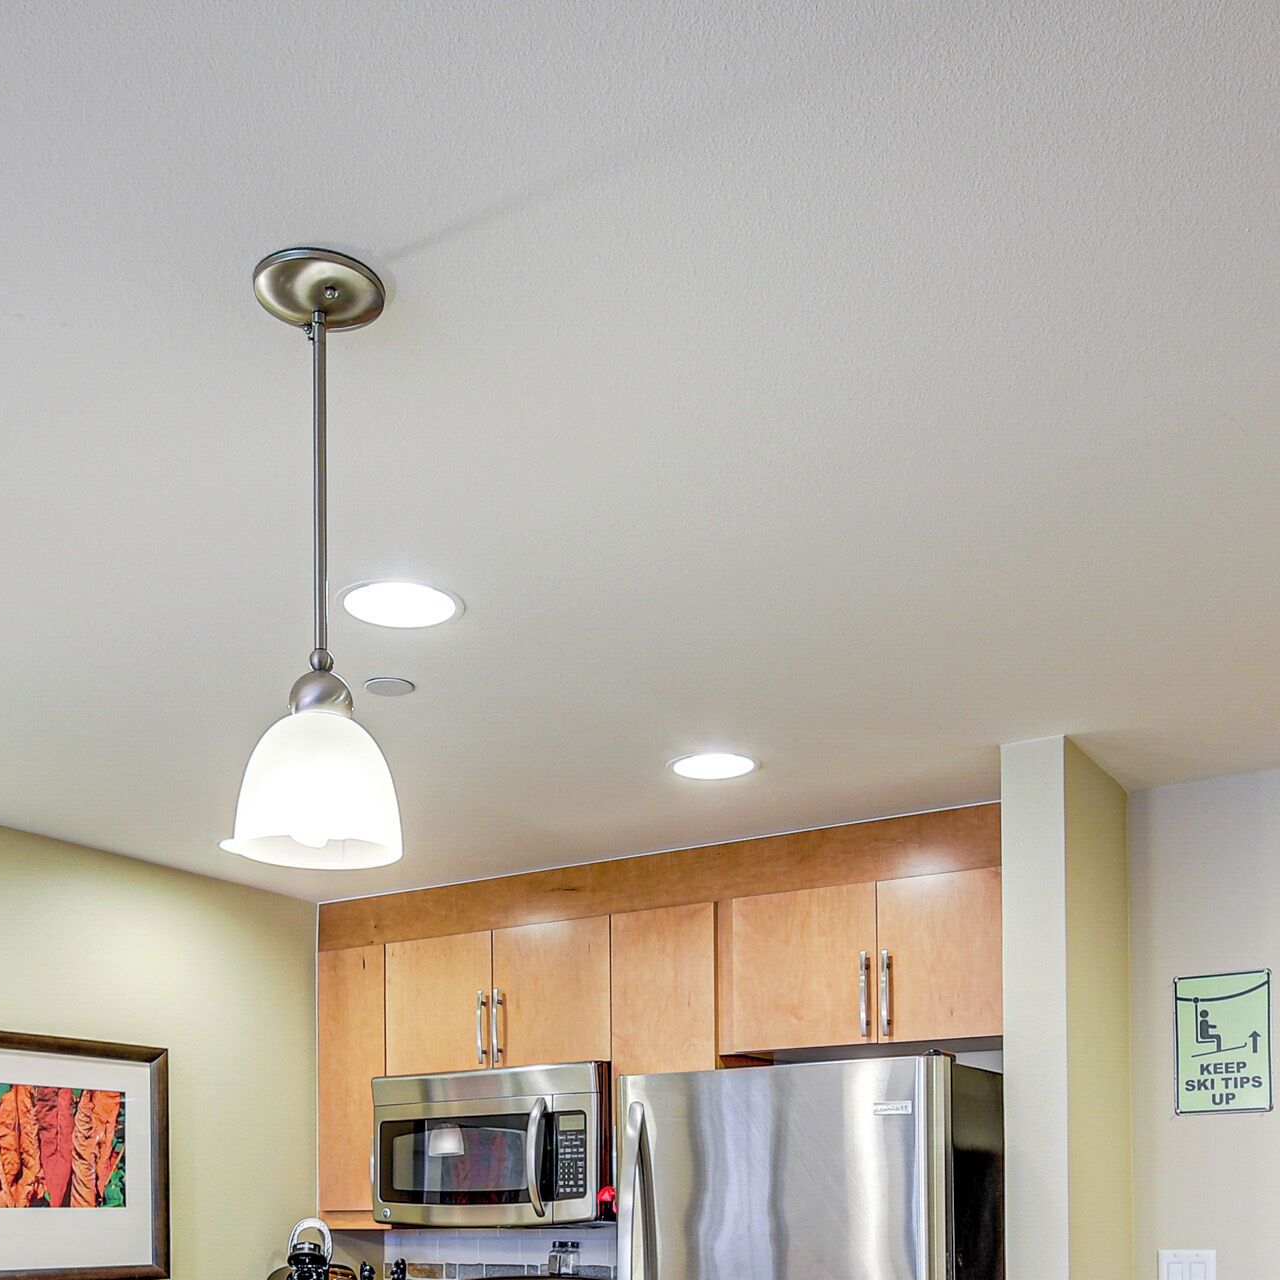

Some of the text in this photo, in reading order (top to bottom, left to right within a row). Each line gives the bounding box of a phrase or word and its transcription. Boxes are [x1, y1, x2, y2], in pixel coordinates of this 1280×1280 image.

[1200, 1061, 1247, 1076] KEEP
[1185, 1075, 1263, 1092] SKI TIPS
[1211, 1092, 1236, 1106] UP
